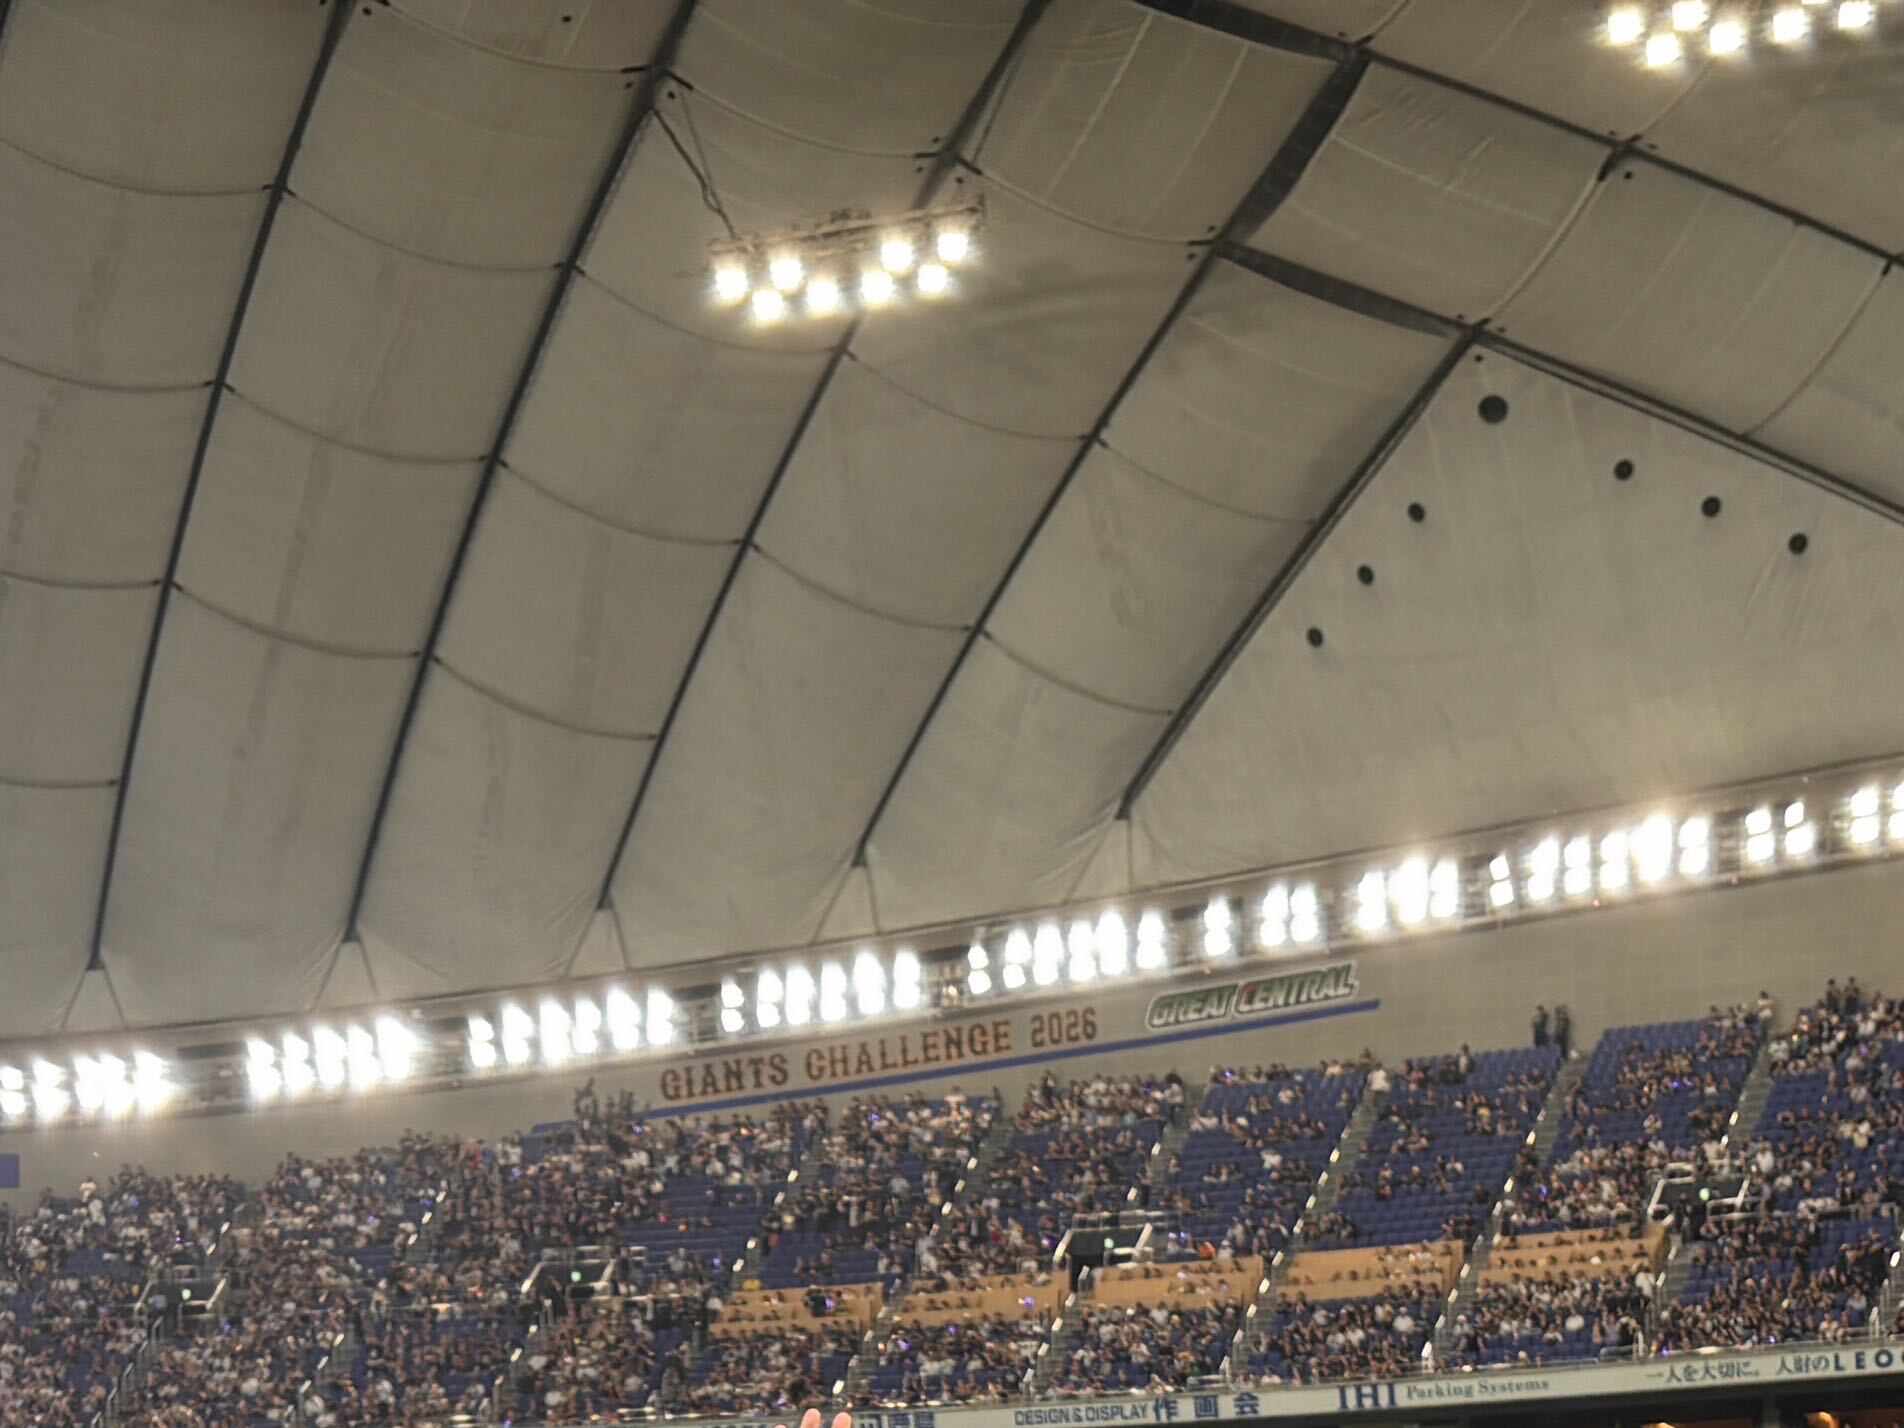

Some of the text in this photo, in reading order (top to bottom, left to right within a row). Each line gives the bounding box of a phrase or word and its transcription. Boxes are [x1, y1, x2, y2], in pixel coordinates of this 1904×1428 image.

[660, 1008, 1097, 1102] GIANTS CHALLENGE 2026
[1337, 1383, 1398, 1410] IHI
